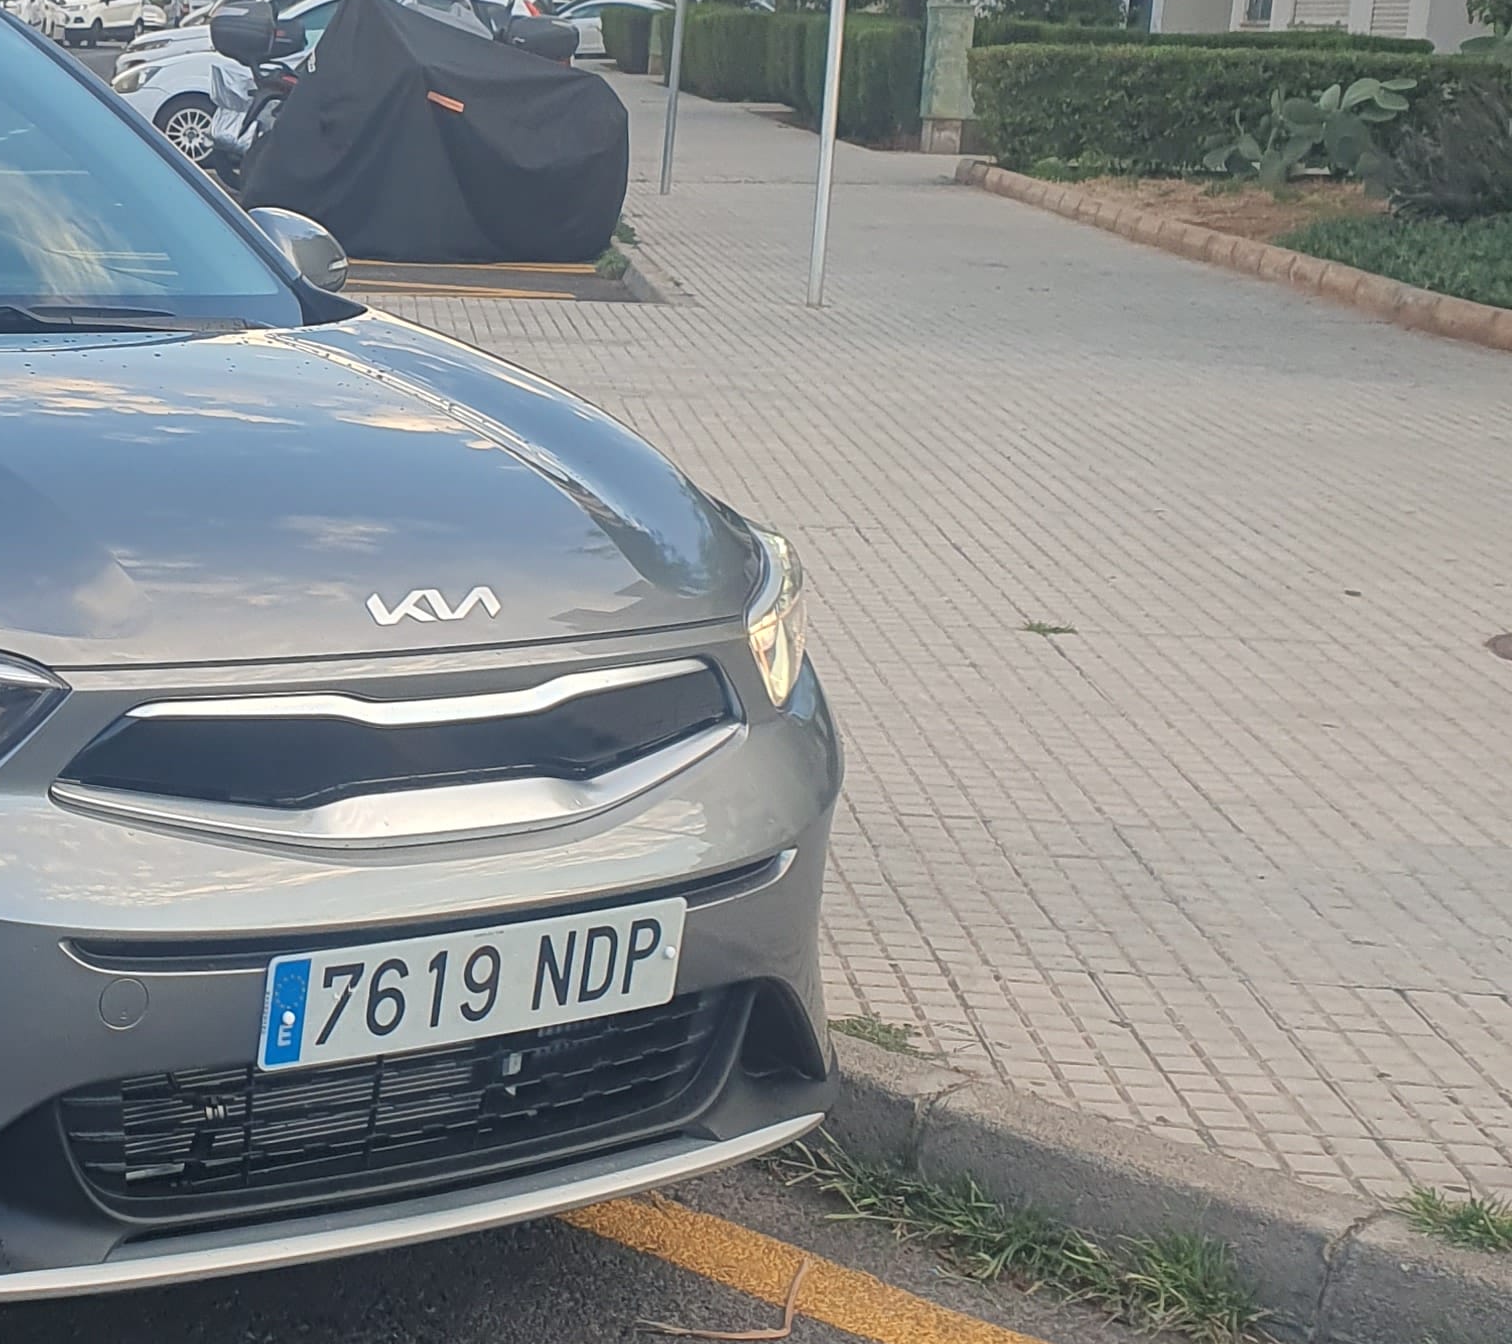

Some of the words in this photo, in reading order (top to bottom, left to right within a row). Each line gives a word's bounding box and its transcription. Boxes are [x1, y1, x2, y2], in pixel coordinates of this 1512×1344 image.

[365, 585, 502, 626] KIA
[315, 945, 502, 1046] 7619
[531, 918, 662, 1011] NDP
[277, 1023, 294, 1047] E
